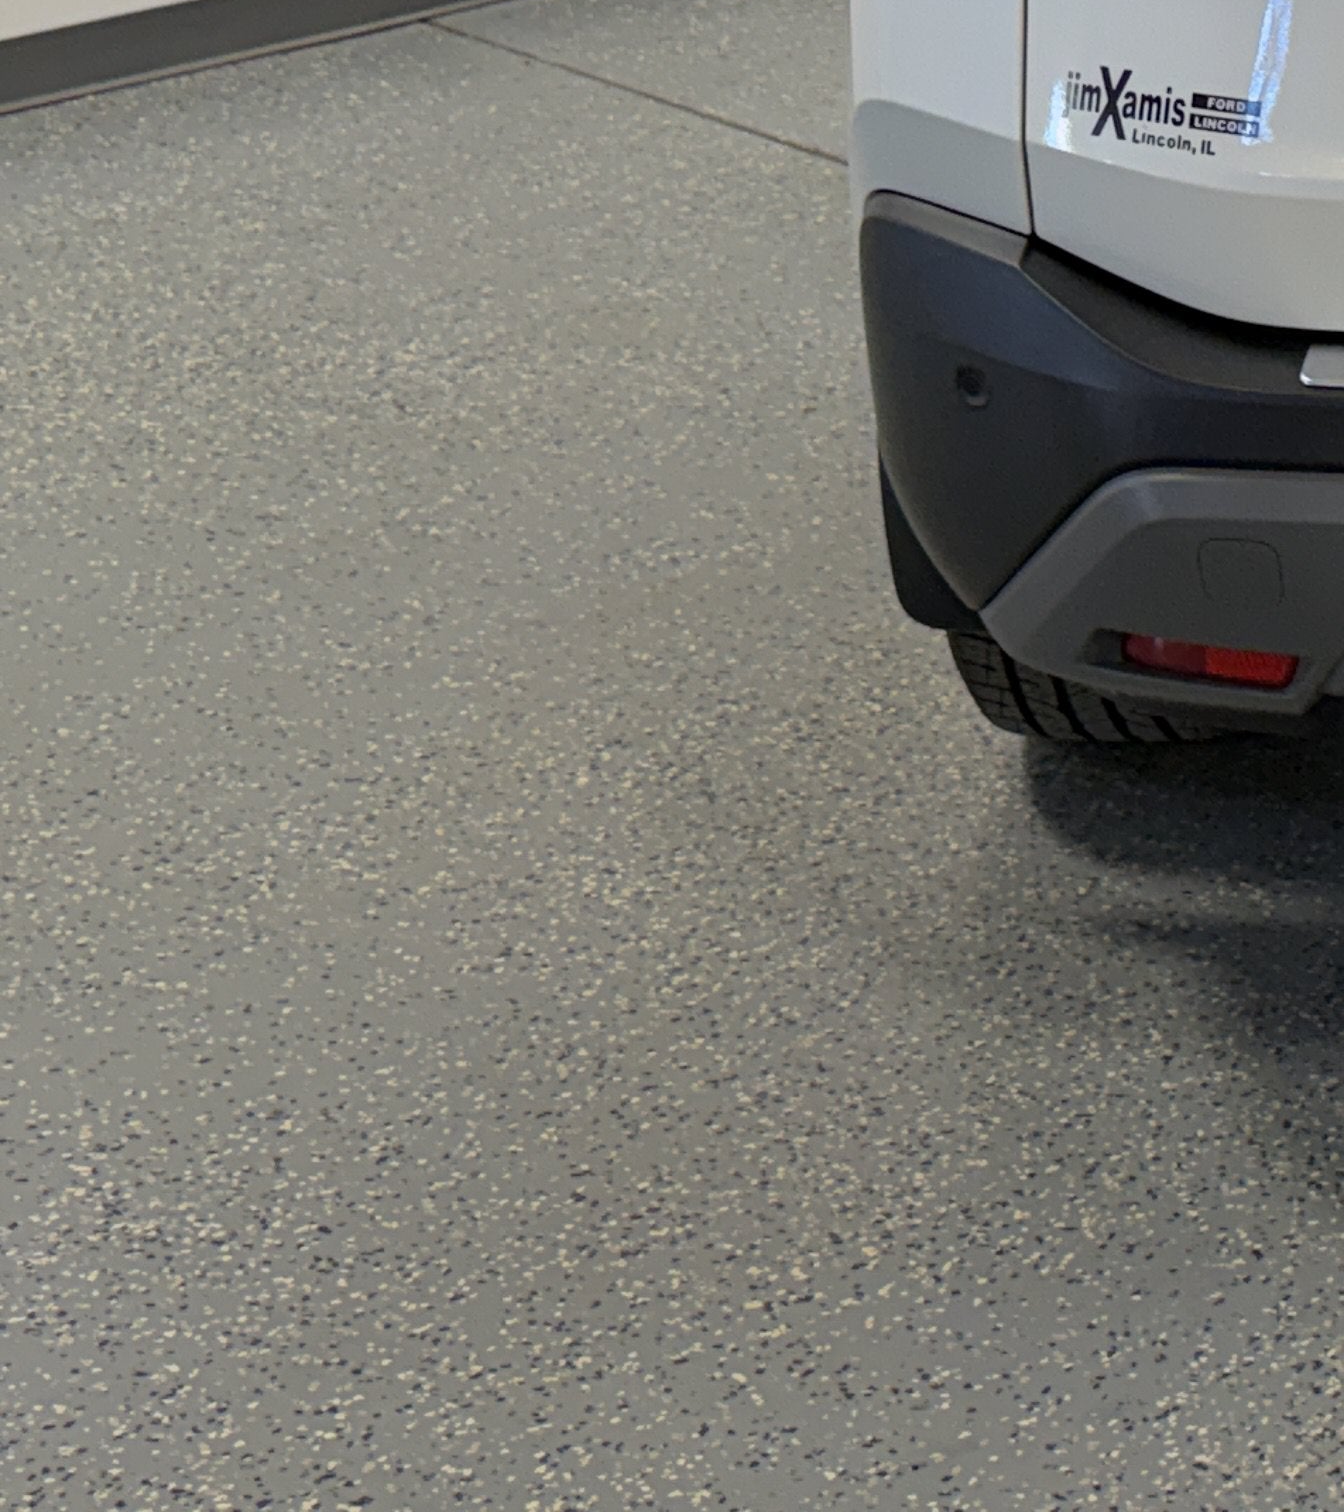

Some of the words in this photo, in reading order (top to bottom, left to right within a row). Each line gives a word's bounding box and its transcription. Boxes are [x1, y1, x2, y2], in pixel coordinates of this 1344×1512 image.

[1206, 98, 1246, 113] FORD
[1131, 129, 1197, 155] Lincoln,
[1201, 140, 1216, 156] IL
